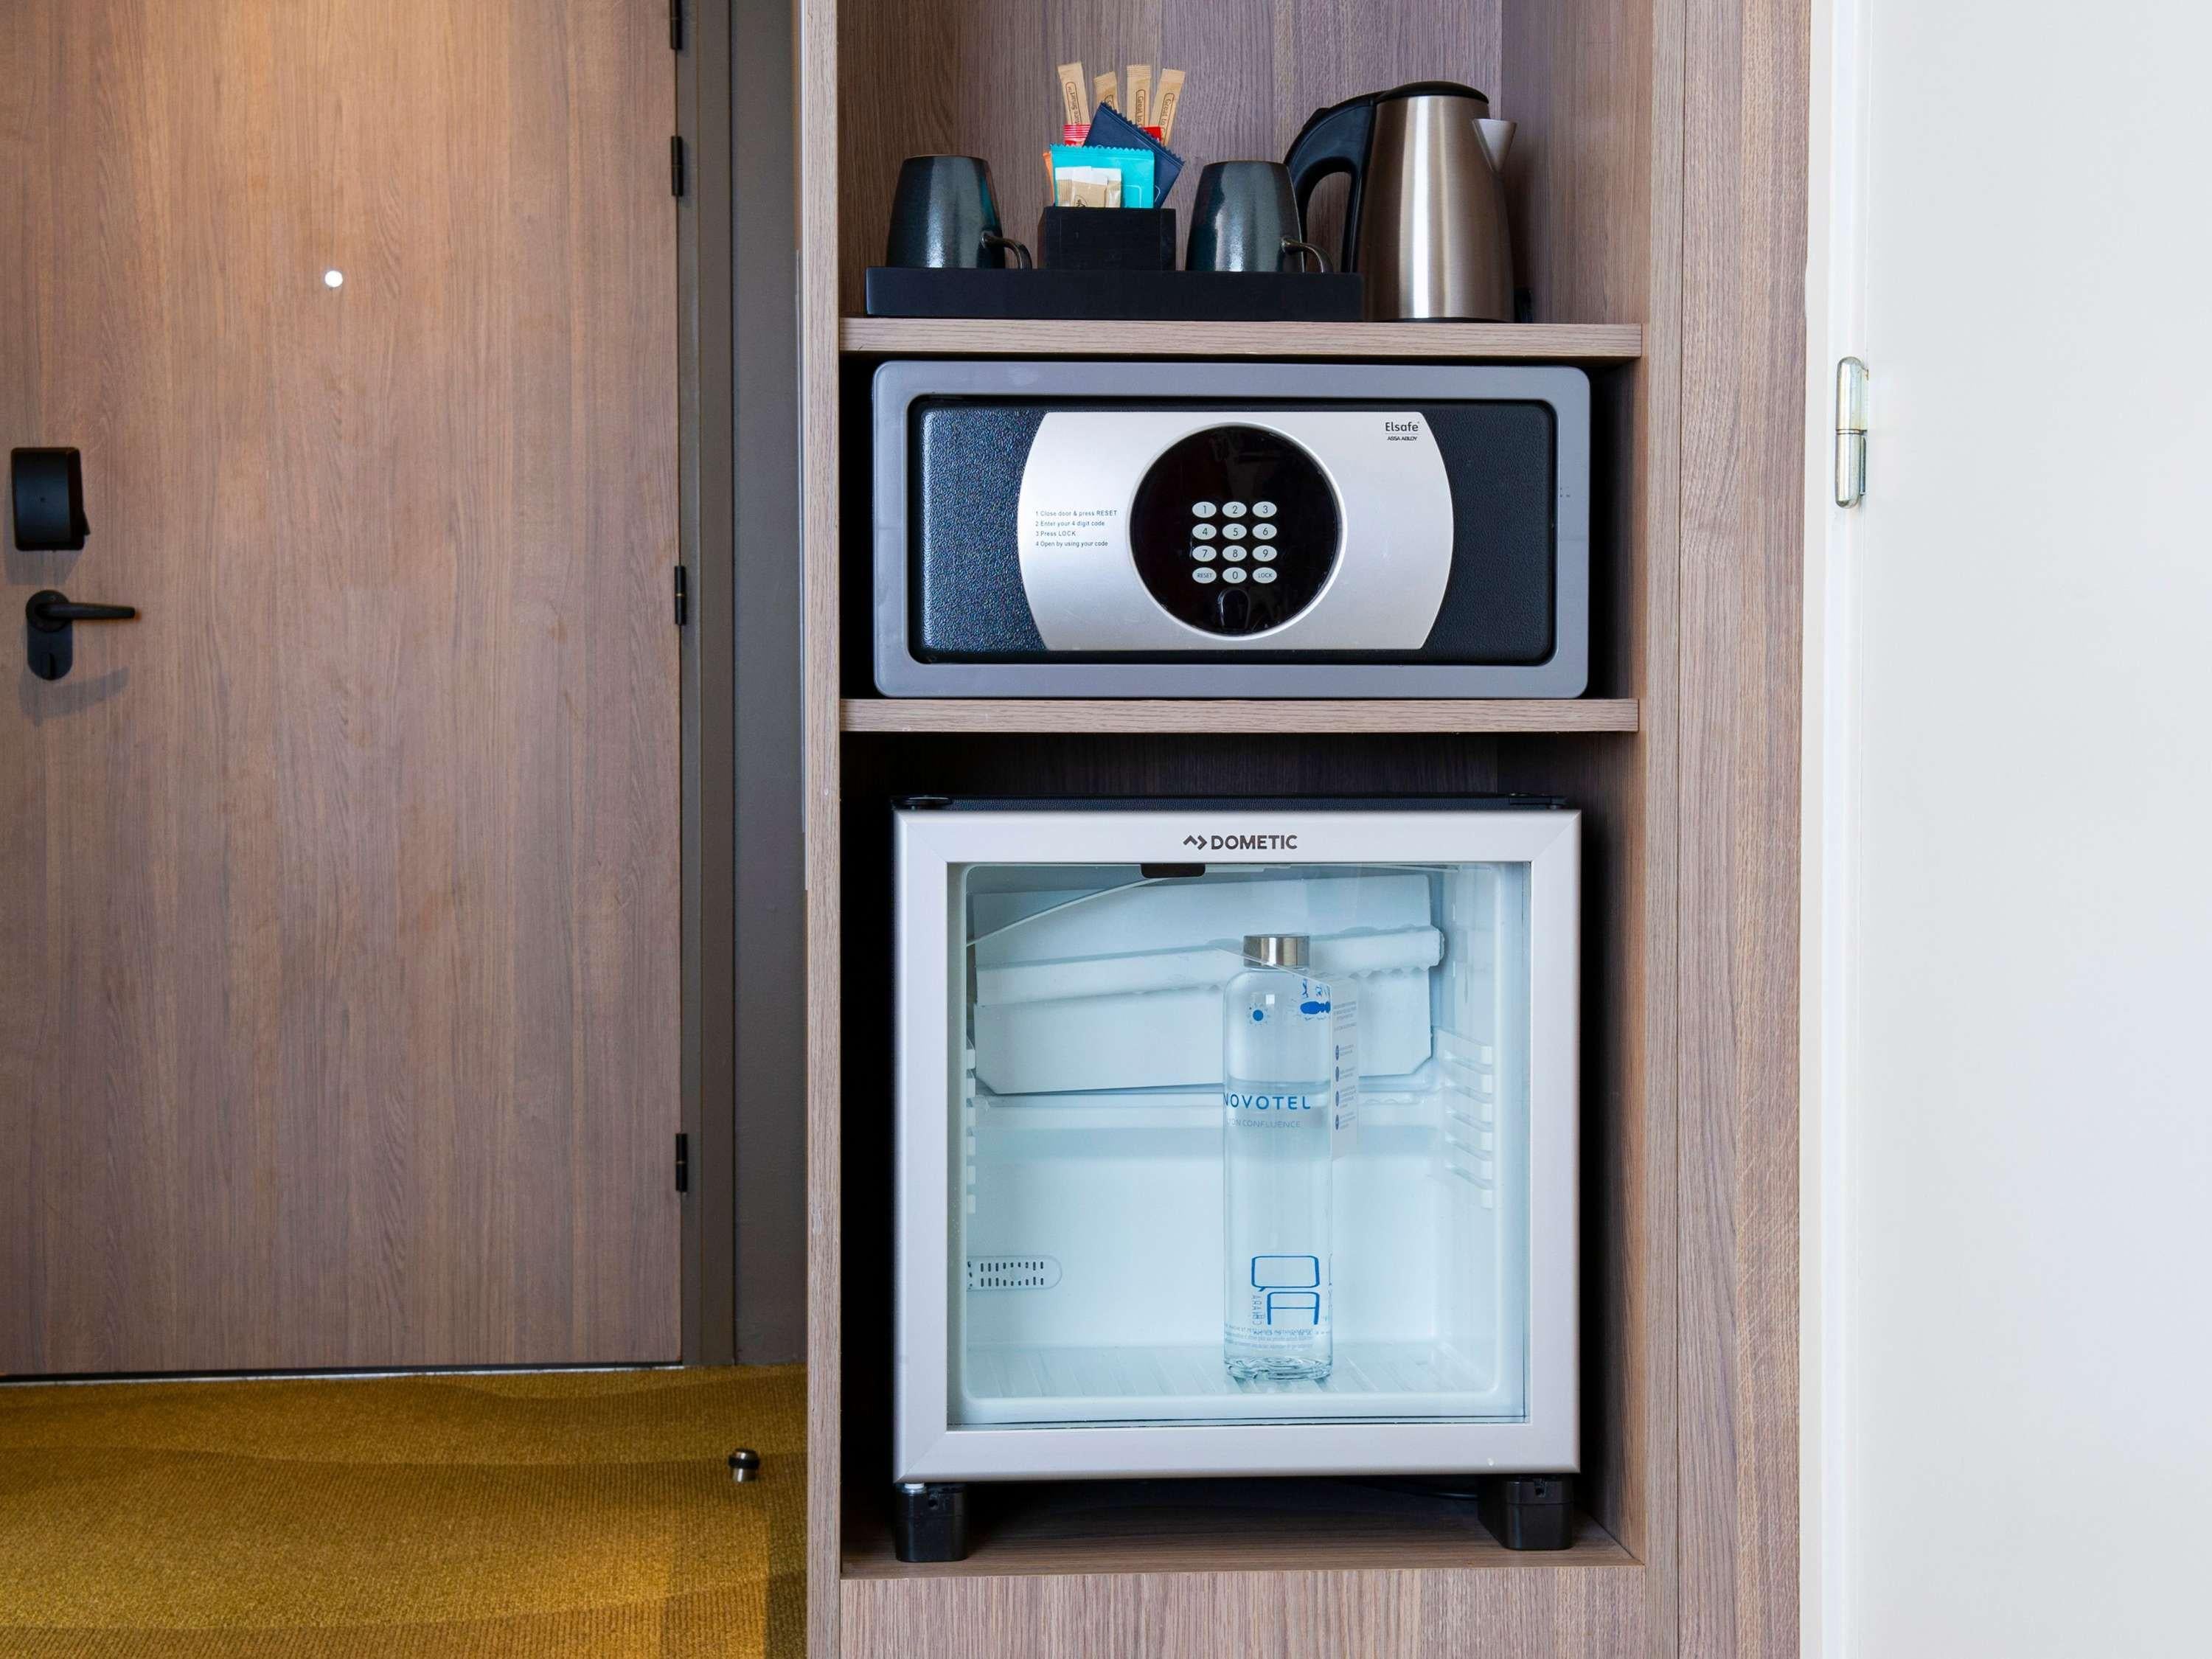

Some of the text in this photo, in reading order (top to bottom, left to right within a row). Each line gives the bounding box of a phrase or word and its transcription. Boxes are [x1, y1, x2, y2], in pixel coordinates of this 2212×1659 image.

[1162, 99, 1172, 116] Great
[1385, 421, 1419, 432] Elsafe
[1211, 834, 1298, 850] DOMETIC
[1223, 1092, 1311, 1110] NOVOTEL
